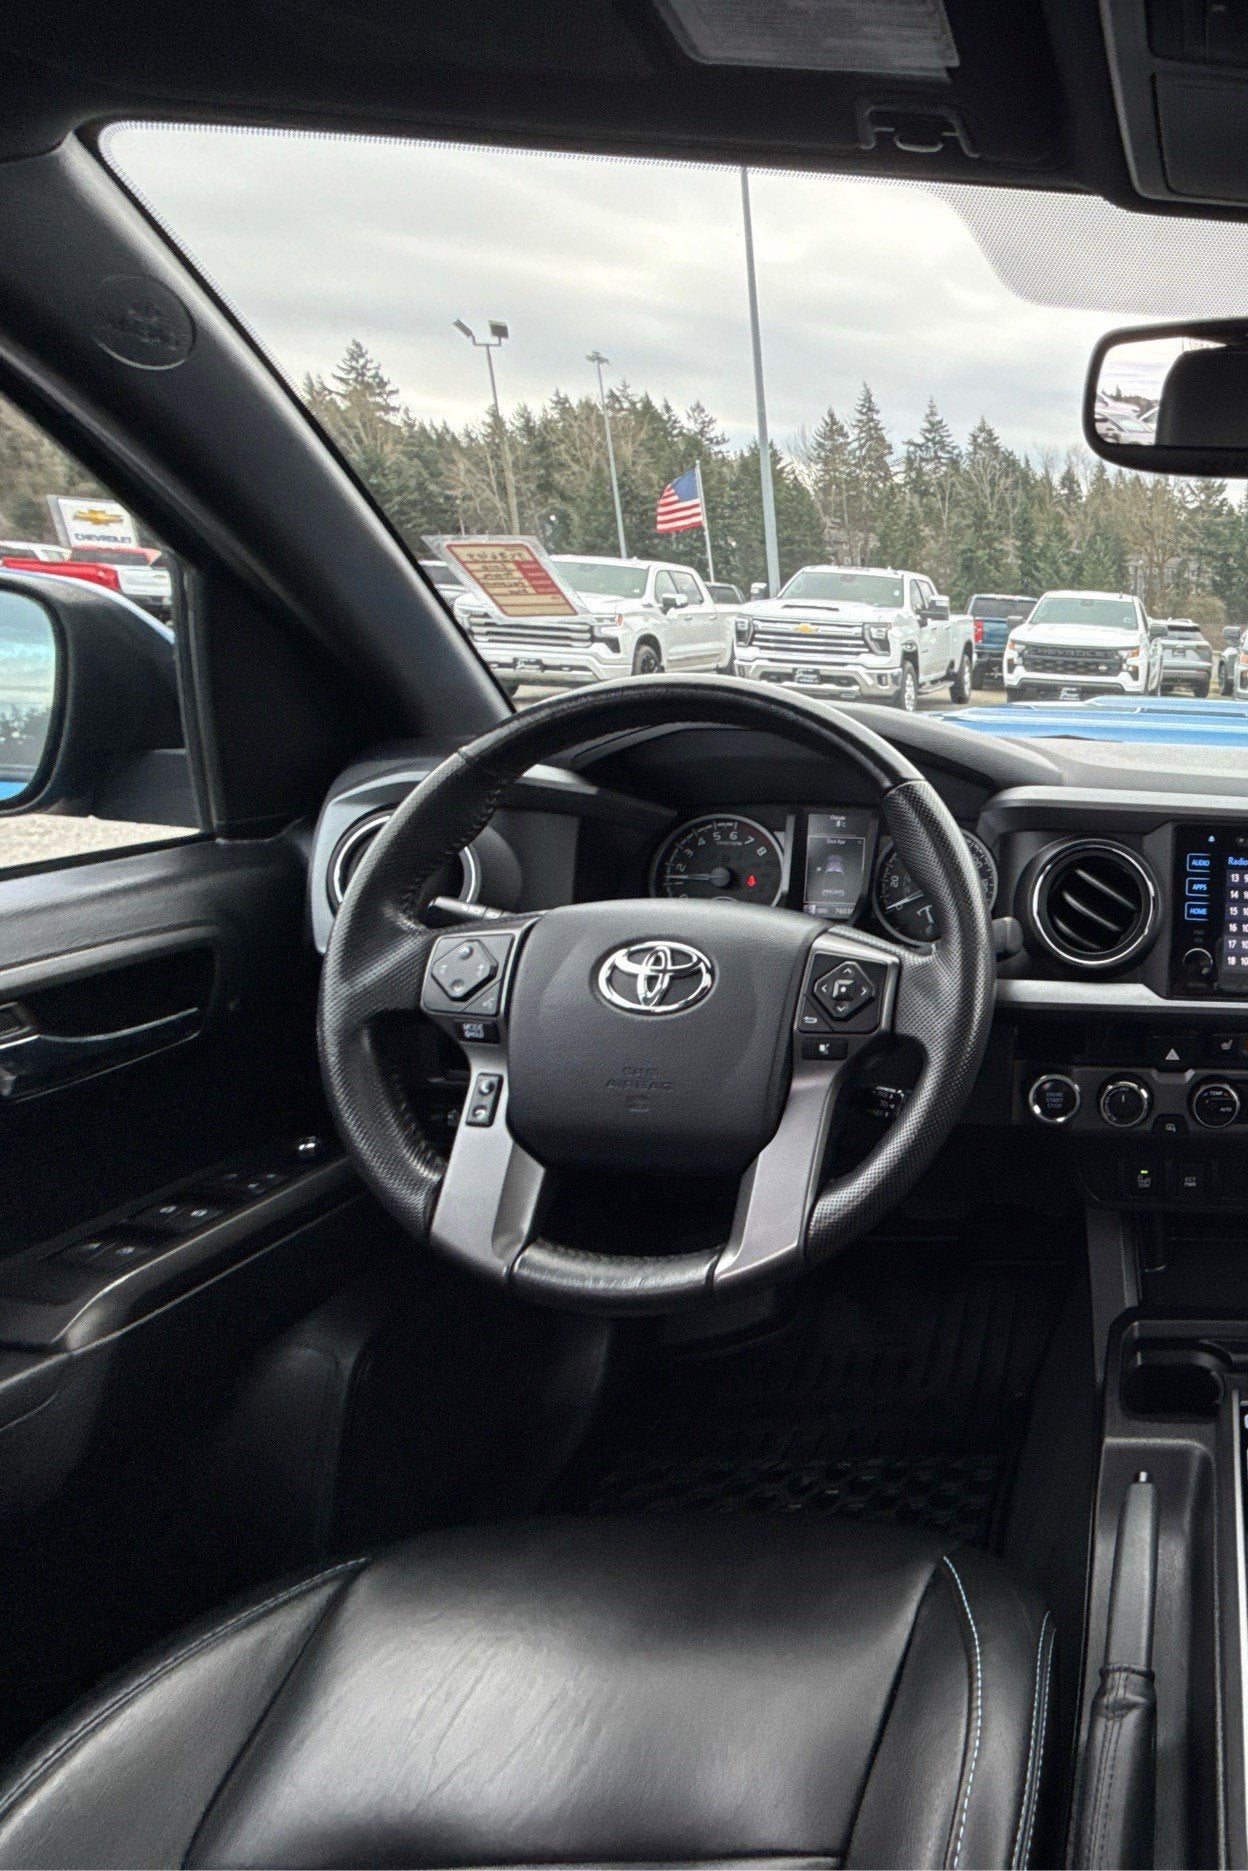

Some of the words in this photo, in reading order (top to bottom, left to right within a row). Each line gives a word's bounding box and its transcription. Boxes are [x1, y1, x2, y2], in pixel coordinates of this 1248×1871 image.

[712, 831, 721, 840] 5
[729, 831, 738, 840] 6
[744, 835, 755, 845] 7
[683, 848, 694, 858] 3
[756, 846, 767, 856] 8
[1191, 859, 1210, 867] AUDIO
[1228, 856, 1248, 866] Radio
[1230, 873, 1240, 883] 13
[1192, 883, 1208, 891] APPS
[1230, 890, 1239, 899] 14
[1229, 906, 1238, 916] 15
[1228, 923, 1238, 933] 16
[1228, 940, 1237, 949] 17
[1227, 956, 1237, 966] 18
